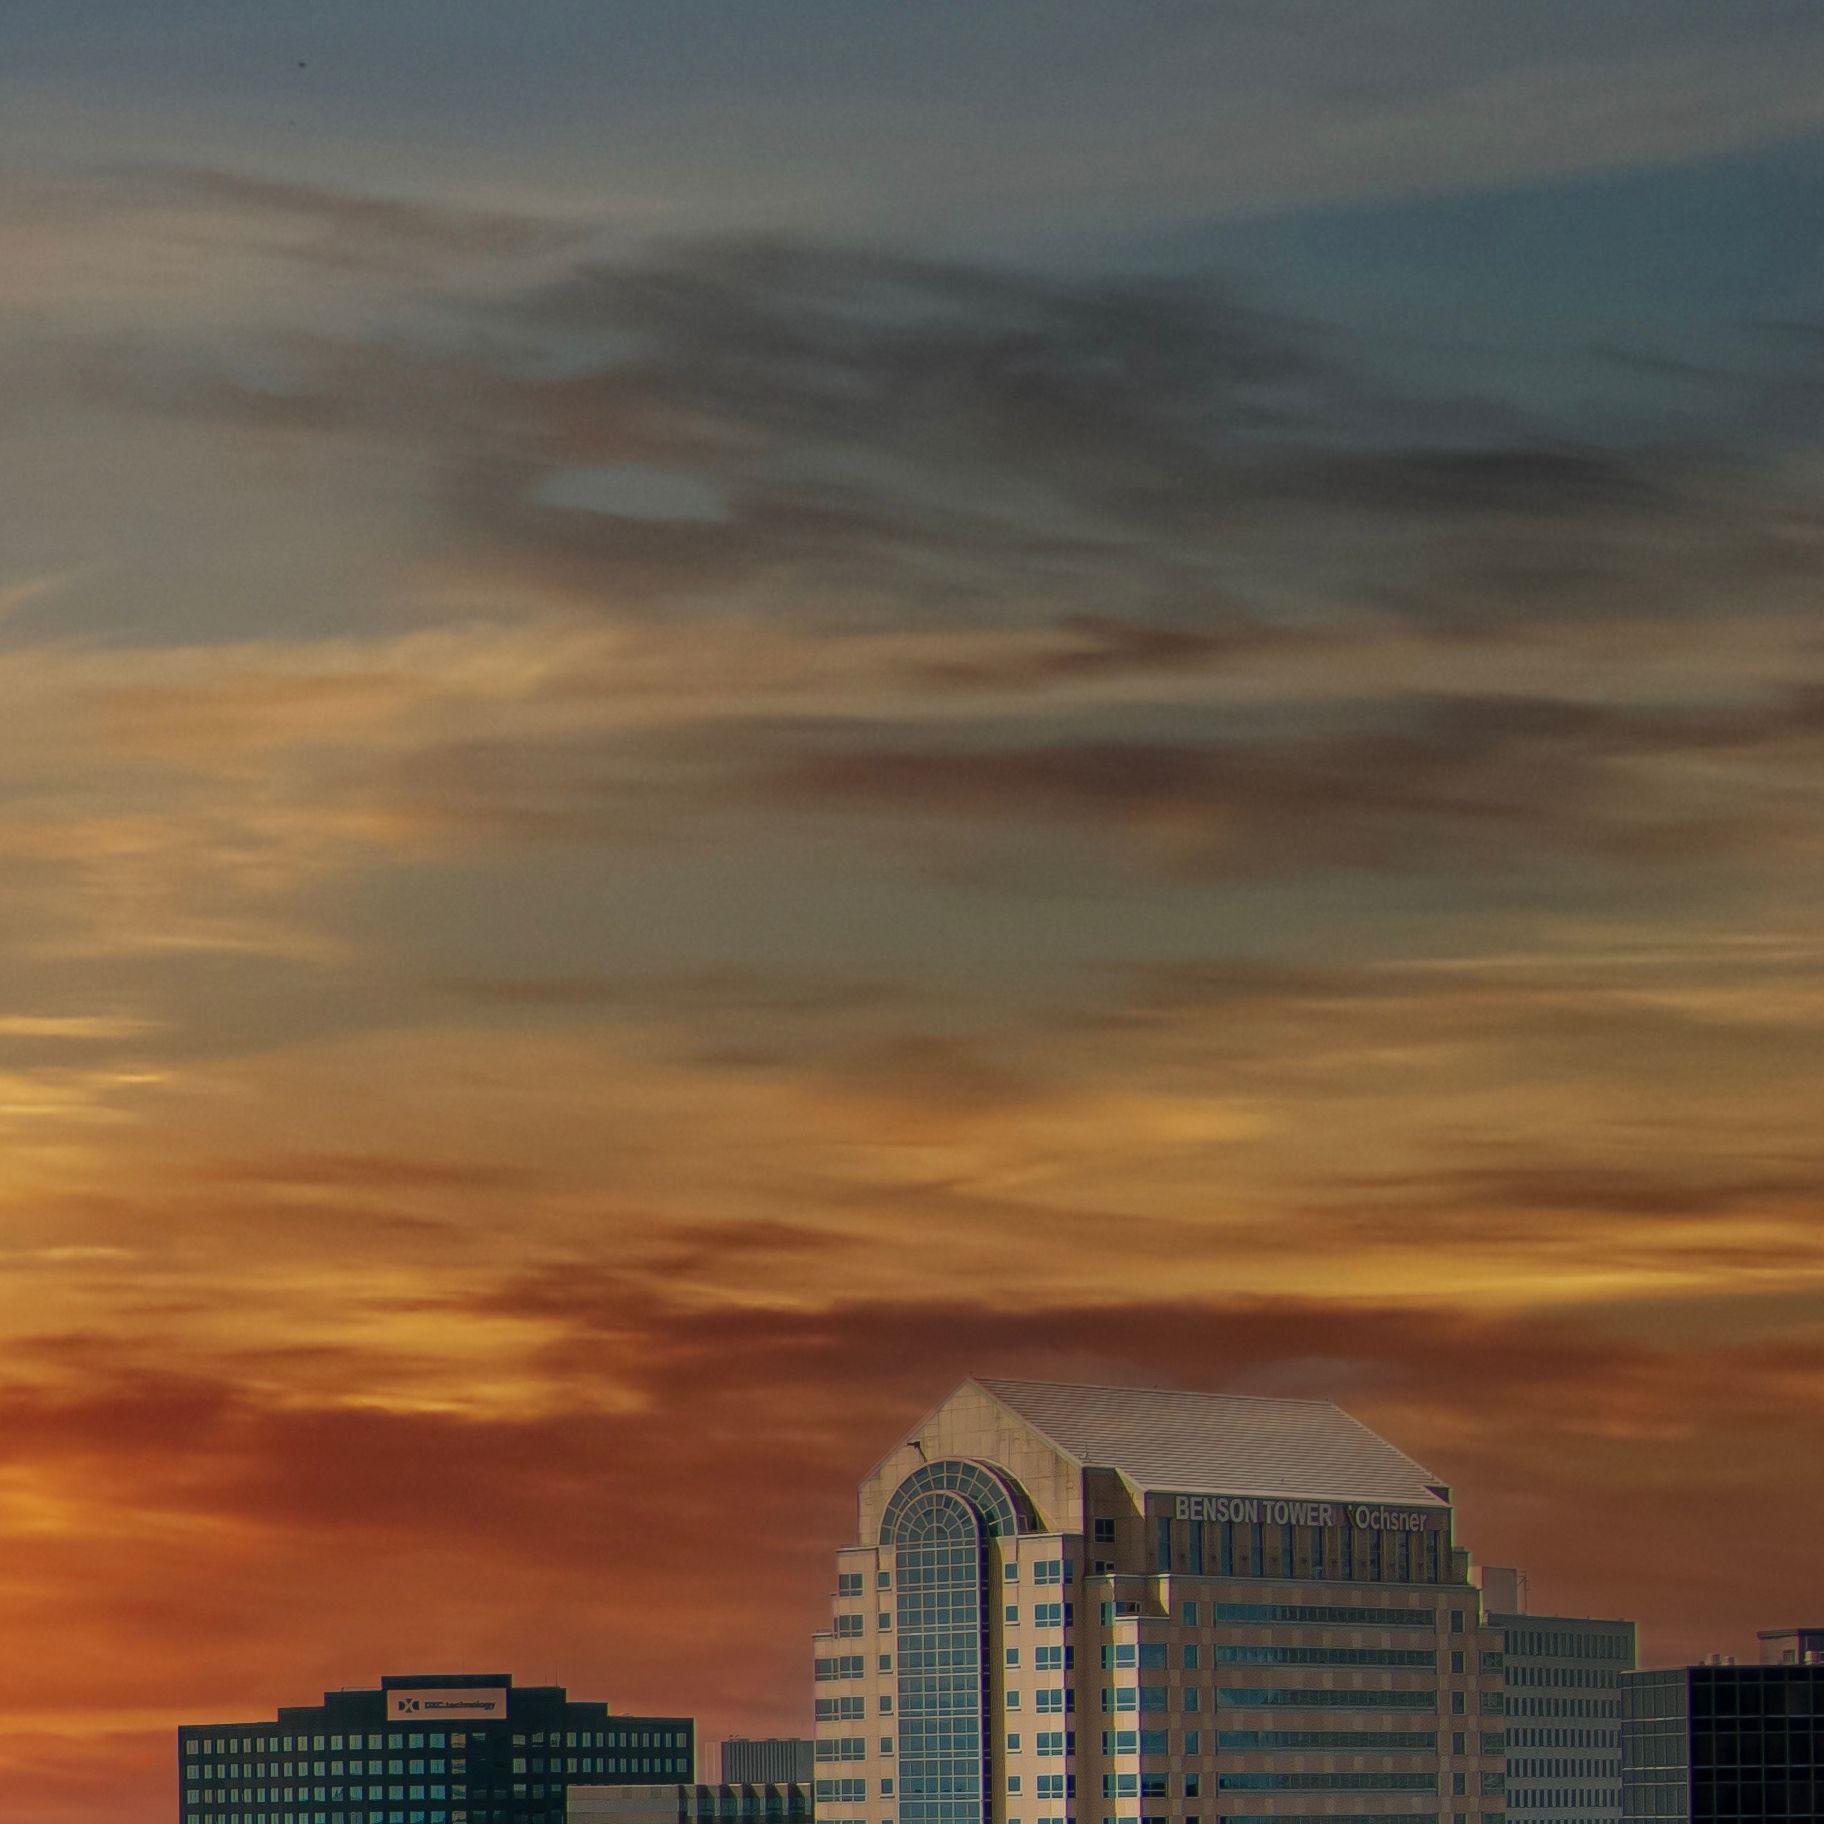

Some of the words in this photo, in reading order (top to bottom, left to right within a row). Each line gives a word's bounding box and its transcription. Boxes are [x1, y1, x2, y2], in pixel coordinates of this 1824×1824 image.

[1175, 1495, 1258, 1524] BENSON
[1263, 1500, 1333, 1527] TOWER
[1355, 1505, 1428, 1532] Ochsner
